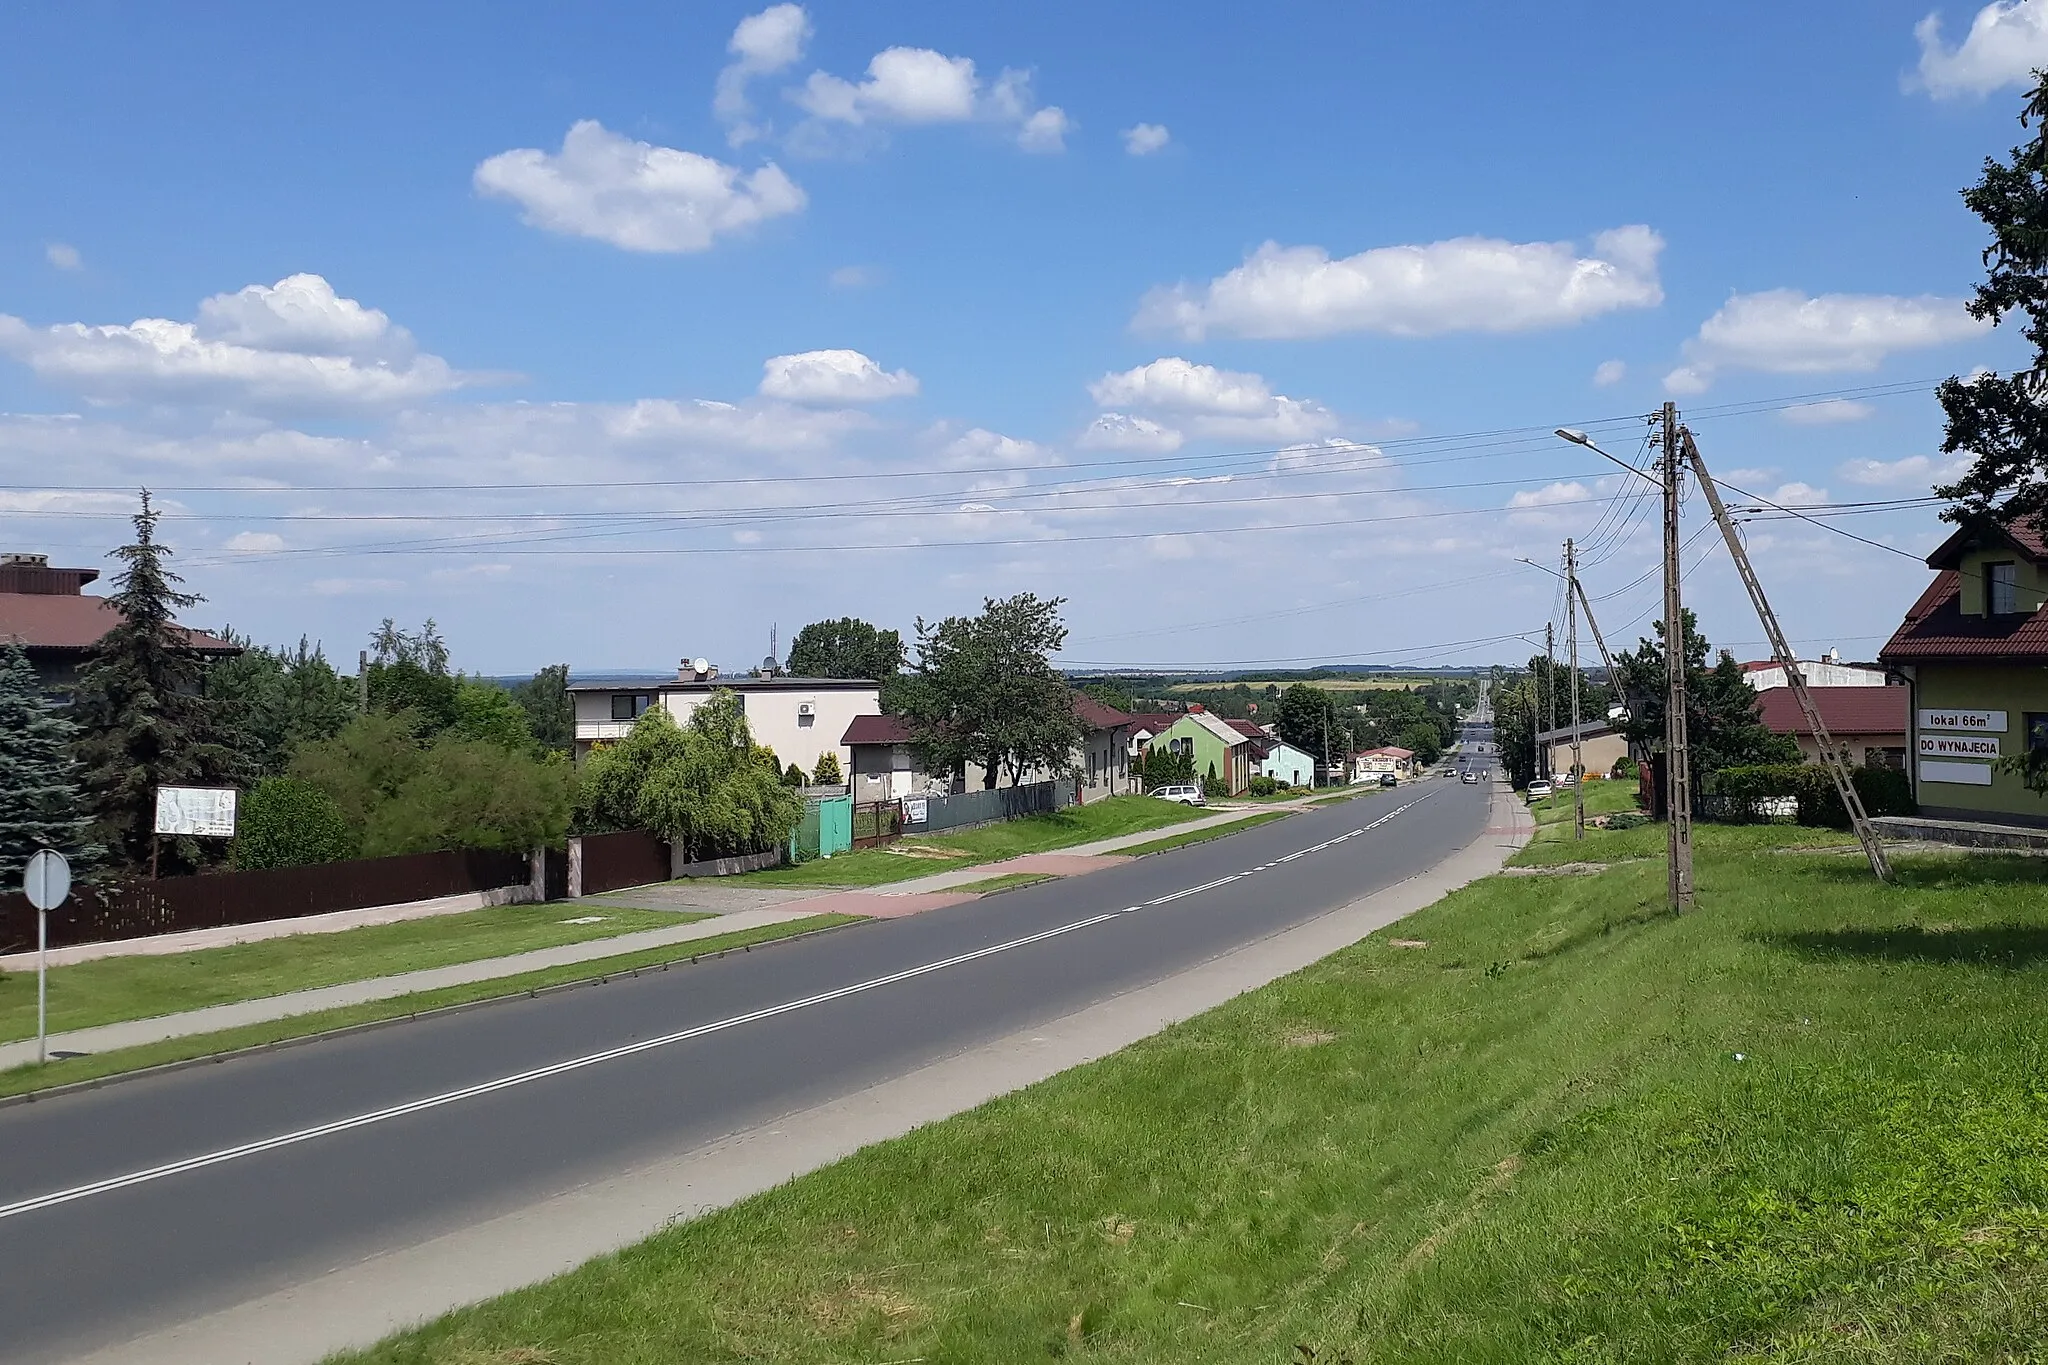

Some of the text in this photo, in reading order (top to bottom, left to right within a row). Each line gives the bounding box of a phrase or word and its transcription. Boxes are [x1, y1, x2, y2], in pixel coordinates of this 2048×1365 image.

[1930, 714, 1958, 726] lokal
[1921, 740, 1997, 754] DO WYNAJĘCIA
